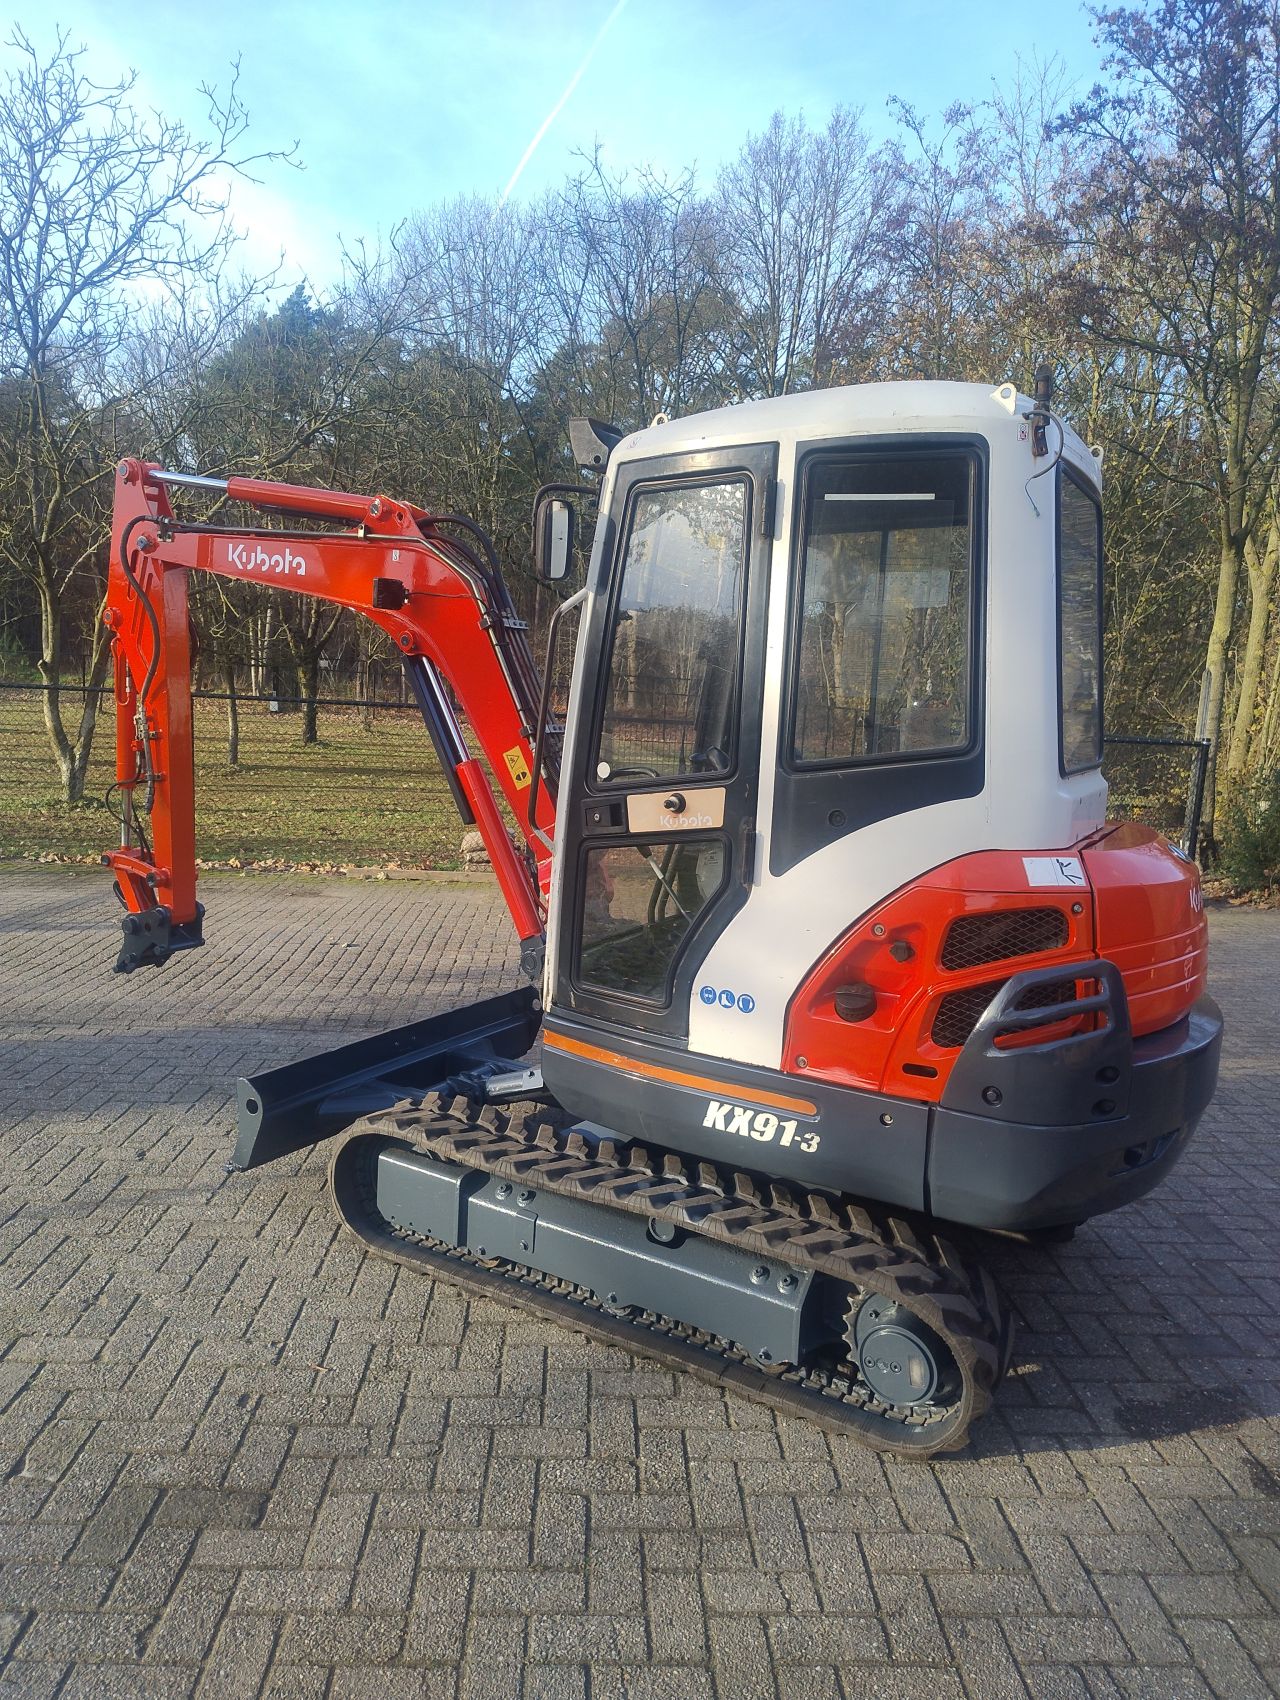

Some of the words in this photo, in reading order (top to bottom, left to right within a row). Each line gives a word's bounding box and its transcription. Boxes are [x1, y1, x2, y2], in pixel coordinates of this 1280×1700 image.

[228, 543, 306, 576] Kubota
[660, 812, 713, 829] Kubota
[702, 1100, 821, 1153] KX91-3
